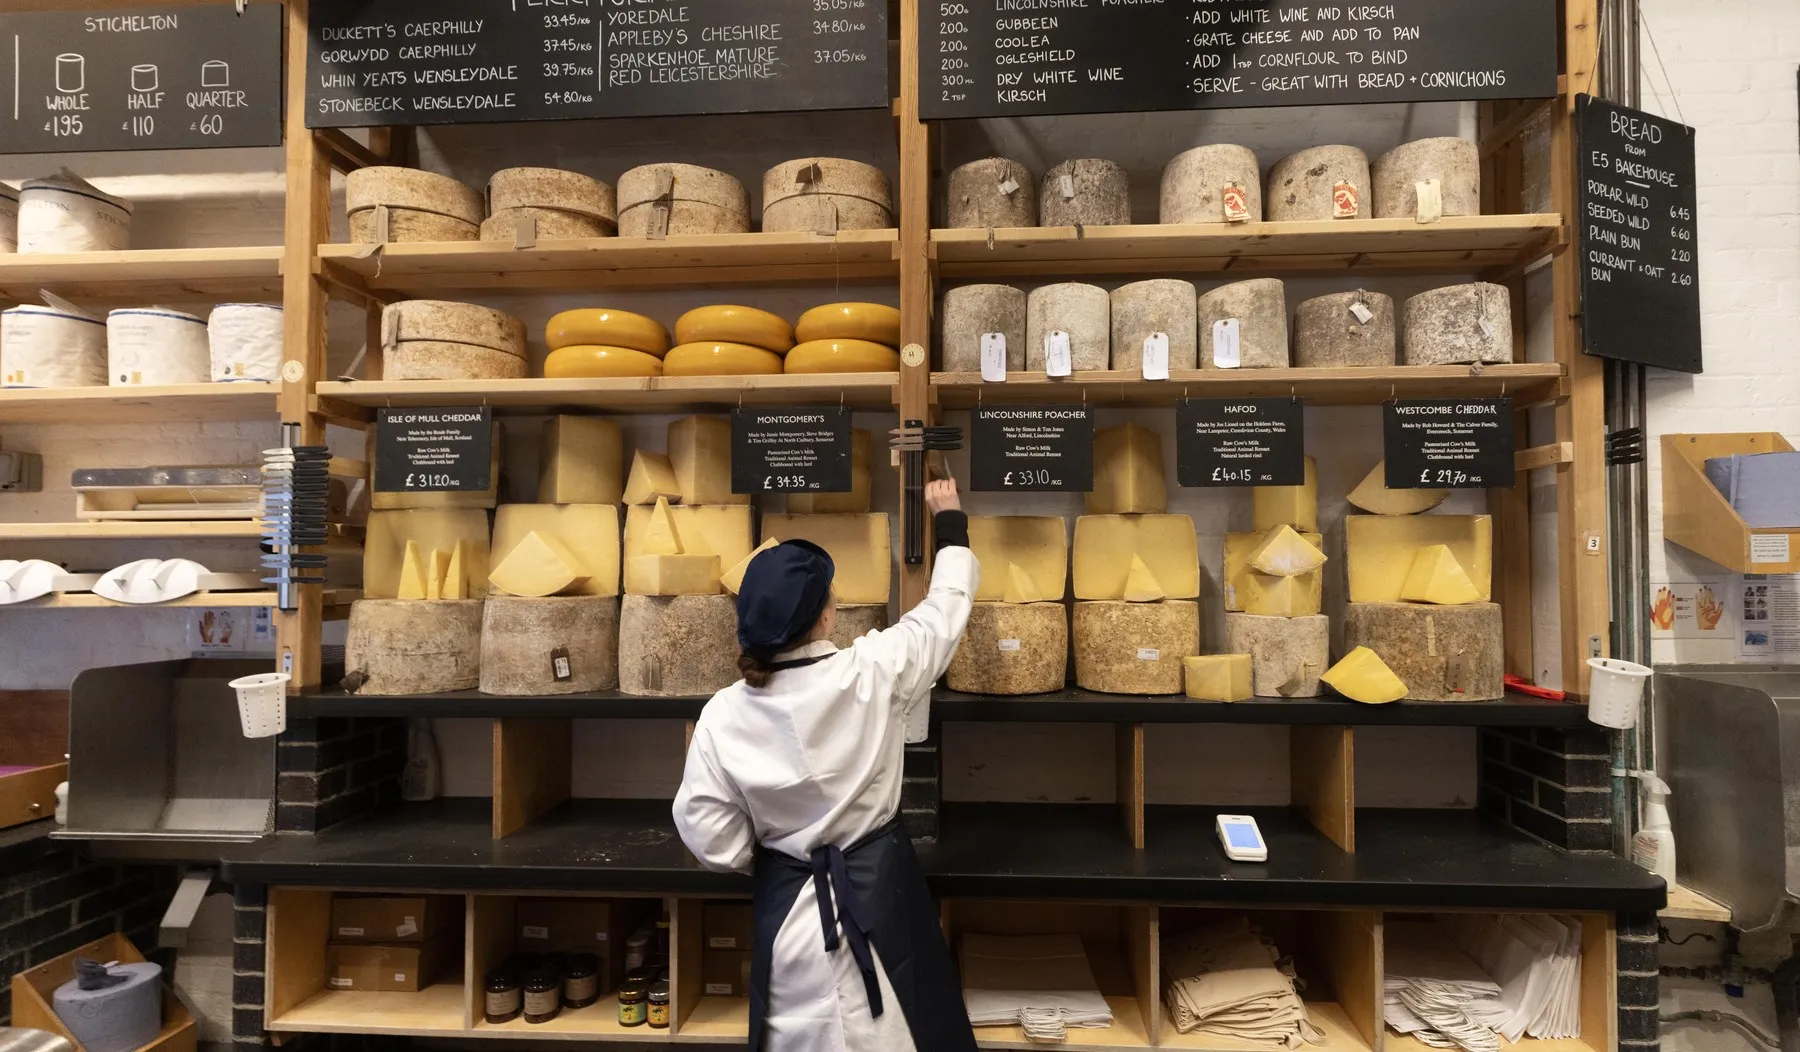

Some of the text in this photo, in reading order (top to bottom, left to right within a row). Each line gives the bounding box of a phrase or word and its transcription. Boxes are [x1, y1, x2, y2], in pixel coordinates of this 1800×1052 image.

[85, 14, 178, 32] STICHELTON
[608, 7, 690, 26] YOREDALE
[996, 17, 1058, 30] GUBBEEN
[1193, 5, 1394, 24] ADD WHITE WINE AND KIRSCH
[322, 23, 396, 40] DUCKETT'S
[404, 19, 483, 38] CAERPHILLY
[608, 28, 688, 46] APPLEBY'S
[701, 24, 783, 42] CHESHIRE
[1194, 26, 1420, 47] GRATE CHEESE AND ADD TO PAN
[995, 35, 1050, 48] COOLEA
[321, 48, 389, 63] GORWYDD
[399, 43, 476, 60] CAERPHILLY
[610, 48, 710, 68] SPARKENHOE
[716, 46, 780, 64] MATURE
[996, 50, 1076, 65] OGLESHIELD
[1193, 54, 1220, 68] ADD
[1259, 50, 1340, 68] CORNFLOUR
[1346, 51, 1364, 64] TO
[1372, 50, 1408, 64] BIND
[321, 73, 356, 88] WHIN
[363, 71, 406, 87] YEATS
[414, 65, 518, 84] WENSLEYDALE
[609, 63, 778, 87] RED LEICESTERSHIRE
[997, 72, 1022, 86] DRY
[1034, 70, 1077, 84] WHITE
[1088, 68, 1124, 82] WINE
[1194, 77, 1243, 93] SERVE
[1262, 76, 1310, 92] GREAT
[1314, 74, 1348, 88] WITH
[1358, 72, 1404, 88] BREAD
[1420, 70, 1506, 88] CORNICHONS
[46, 94, 90, 110] WHOLE
[128, 92, 165, 109] HALF
[186, 91, 248, 108] QUARTER
[319, 97, 404, 113] STONEBECK
[413, 93, 516, 110] WENSLEYDALE
[997, 90, 1046, 104] KIRSCH
[1610, 110, 1662, 144] BREAD
[1625, 144, 1646, 157] FROM
[1592, 151, 1678, 188] E5 BAKEHOUSE
[1588, 180, 1690, 221] POPLAR WILD 6.45
[1588, 202, 1690, 241] SEEDED WILD 6.60
[1590, 225, 1690, 262] PLAIN BUN 2.20
[1590, 250, 1636, 273] CURRANT
[1645, 264, 1664, 278] OAT
[1672, 273, 1692, 286] 2.60
[1592, 266, 1611, 282] BUN
[1045, 410, 1086, 418] POACHER
[1224, 405, 1256, 413] HAFOD
[1396, 404, 1497, 414] WESTCOMBE CHEDDAR
[388, 416, 402, 424] ISLE
[418, 414, 440, 422] MULL
[442, 414, 482, 422] CHEDDAR
[758, 415, 824, 424] MONTGOMERY'S
[406, 473, 414, 487] £
[764, 476, 772, 489] £
[776, 475, 806, 488] 34.35
[1004, 472, 1013, 485] £
[1019, 469, 1049, 485] 33.10
[1420, 469, 1430, 482] £
[1436, 470, 1467, 486] 29.70
[1591, 540, 1596, 549] 3
